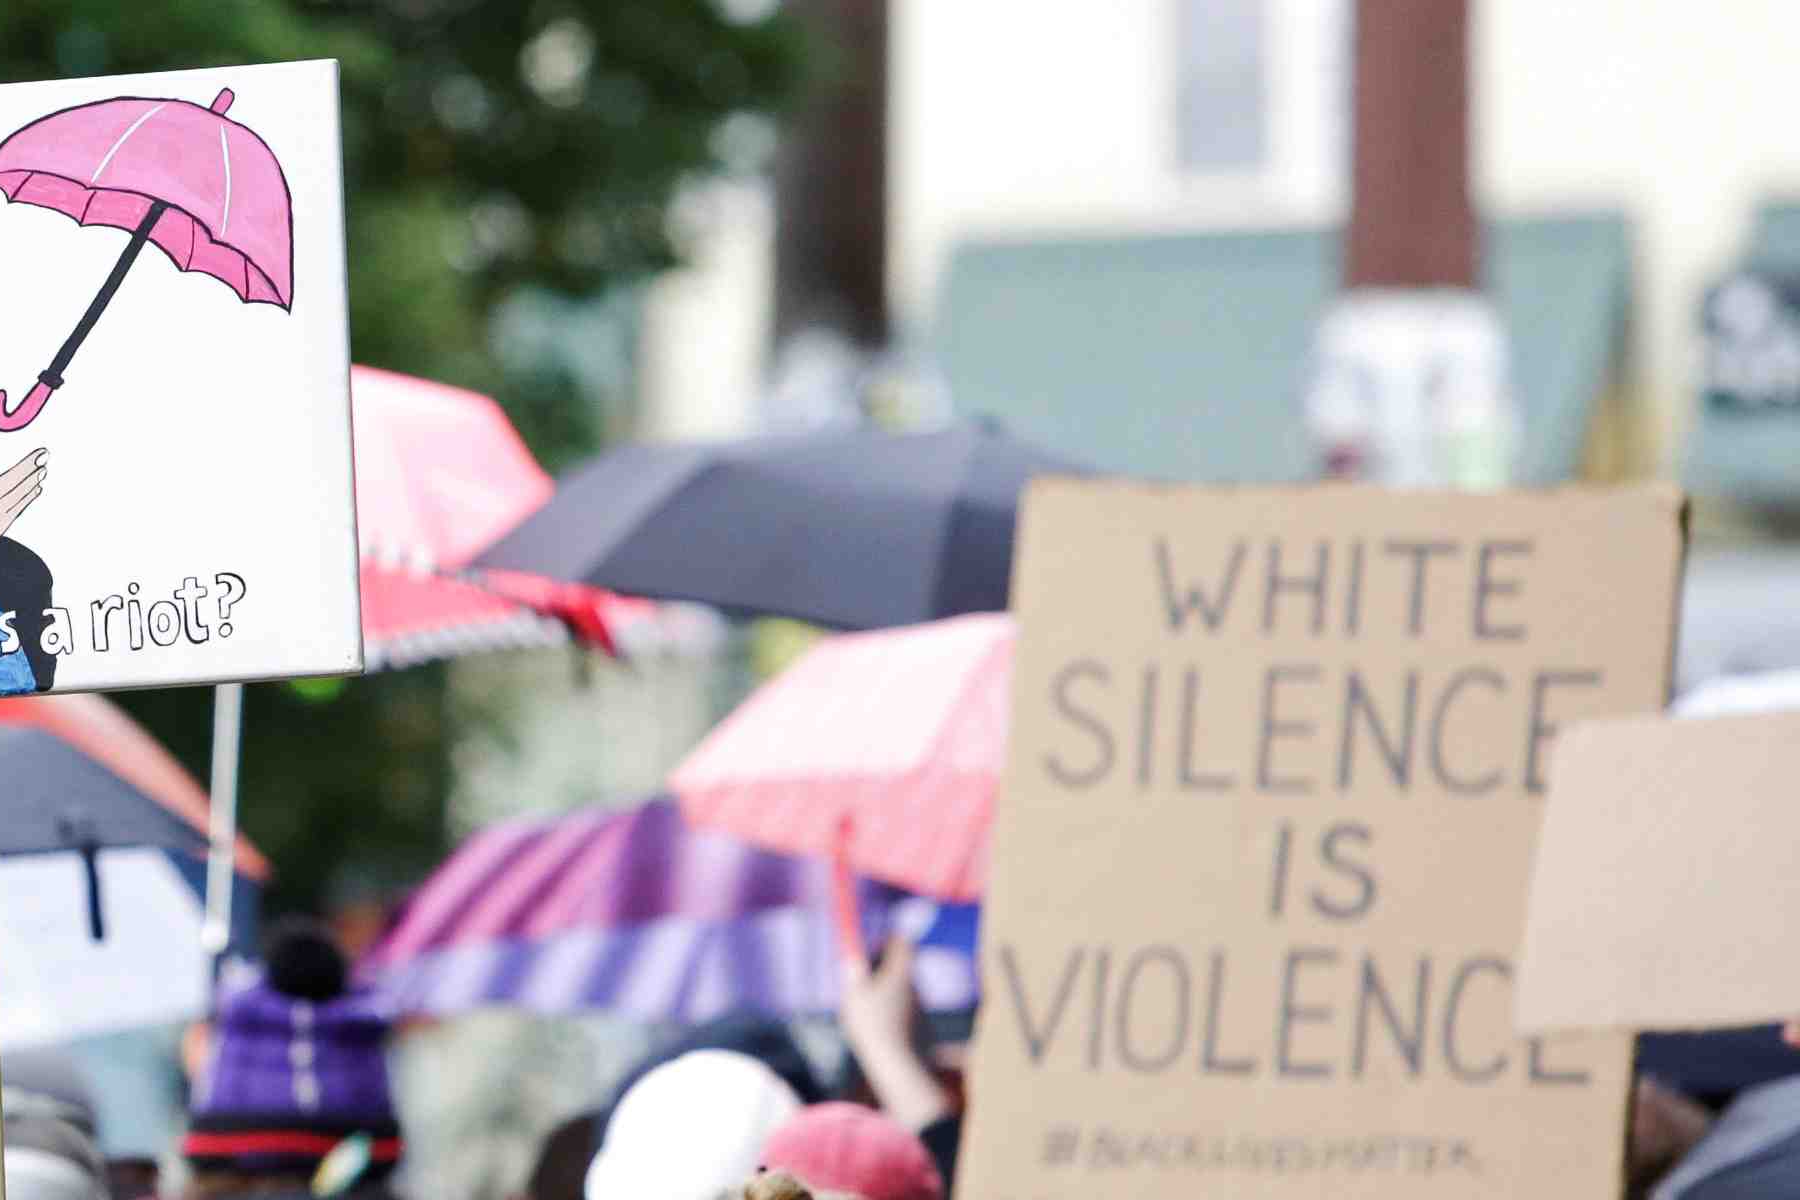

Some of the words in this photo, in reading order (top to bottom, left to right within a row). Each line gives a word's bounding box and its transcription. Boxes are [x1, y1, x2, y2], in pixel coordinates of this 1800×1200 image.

[39, 606, 74, 656] a
[90, 571, 247, 653] riot?
[1152, 536, 1535, 640] WHITE
[1042, 660, 1603, 797] SILENCE
[1267, 820, 1380, 921] IS
